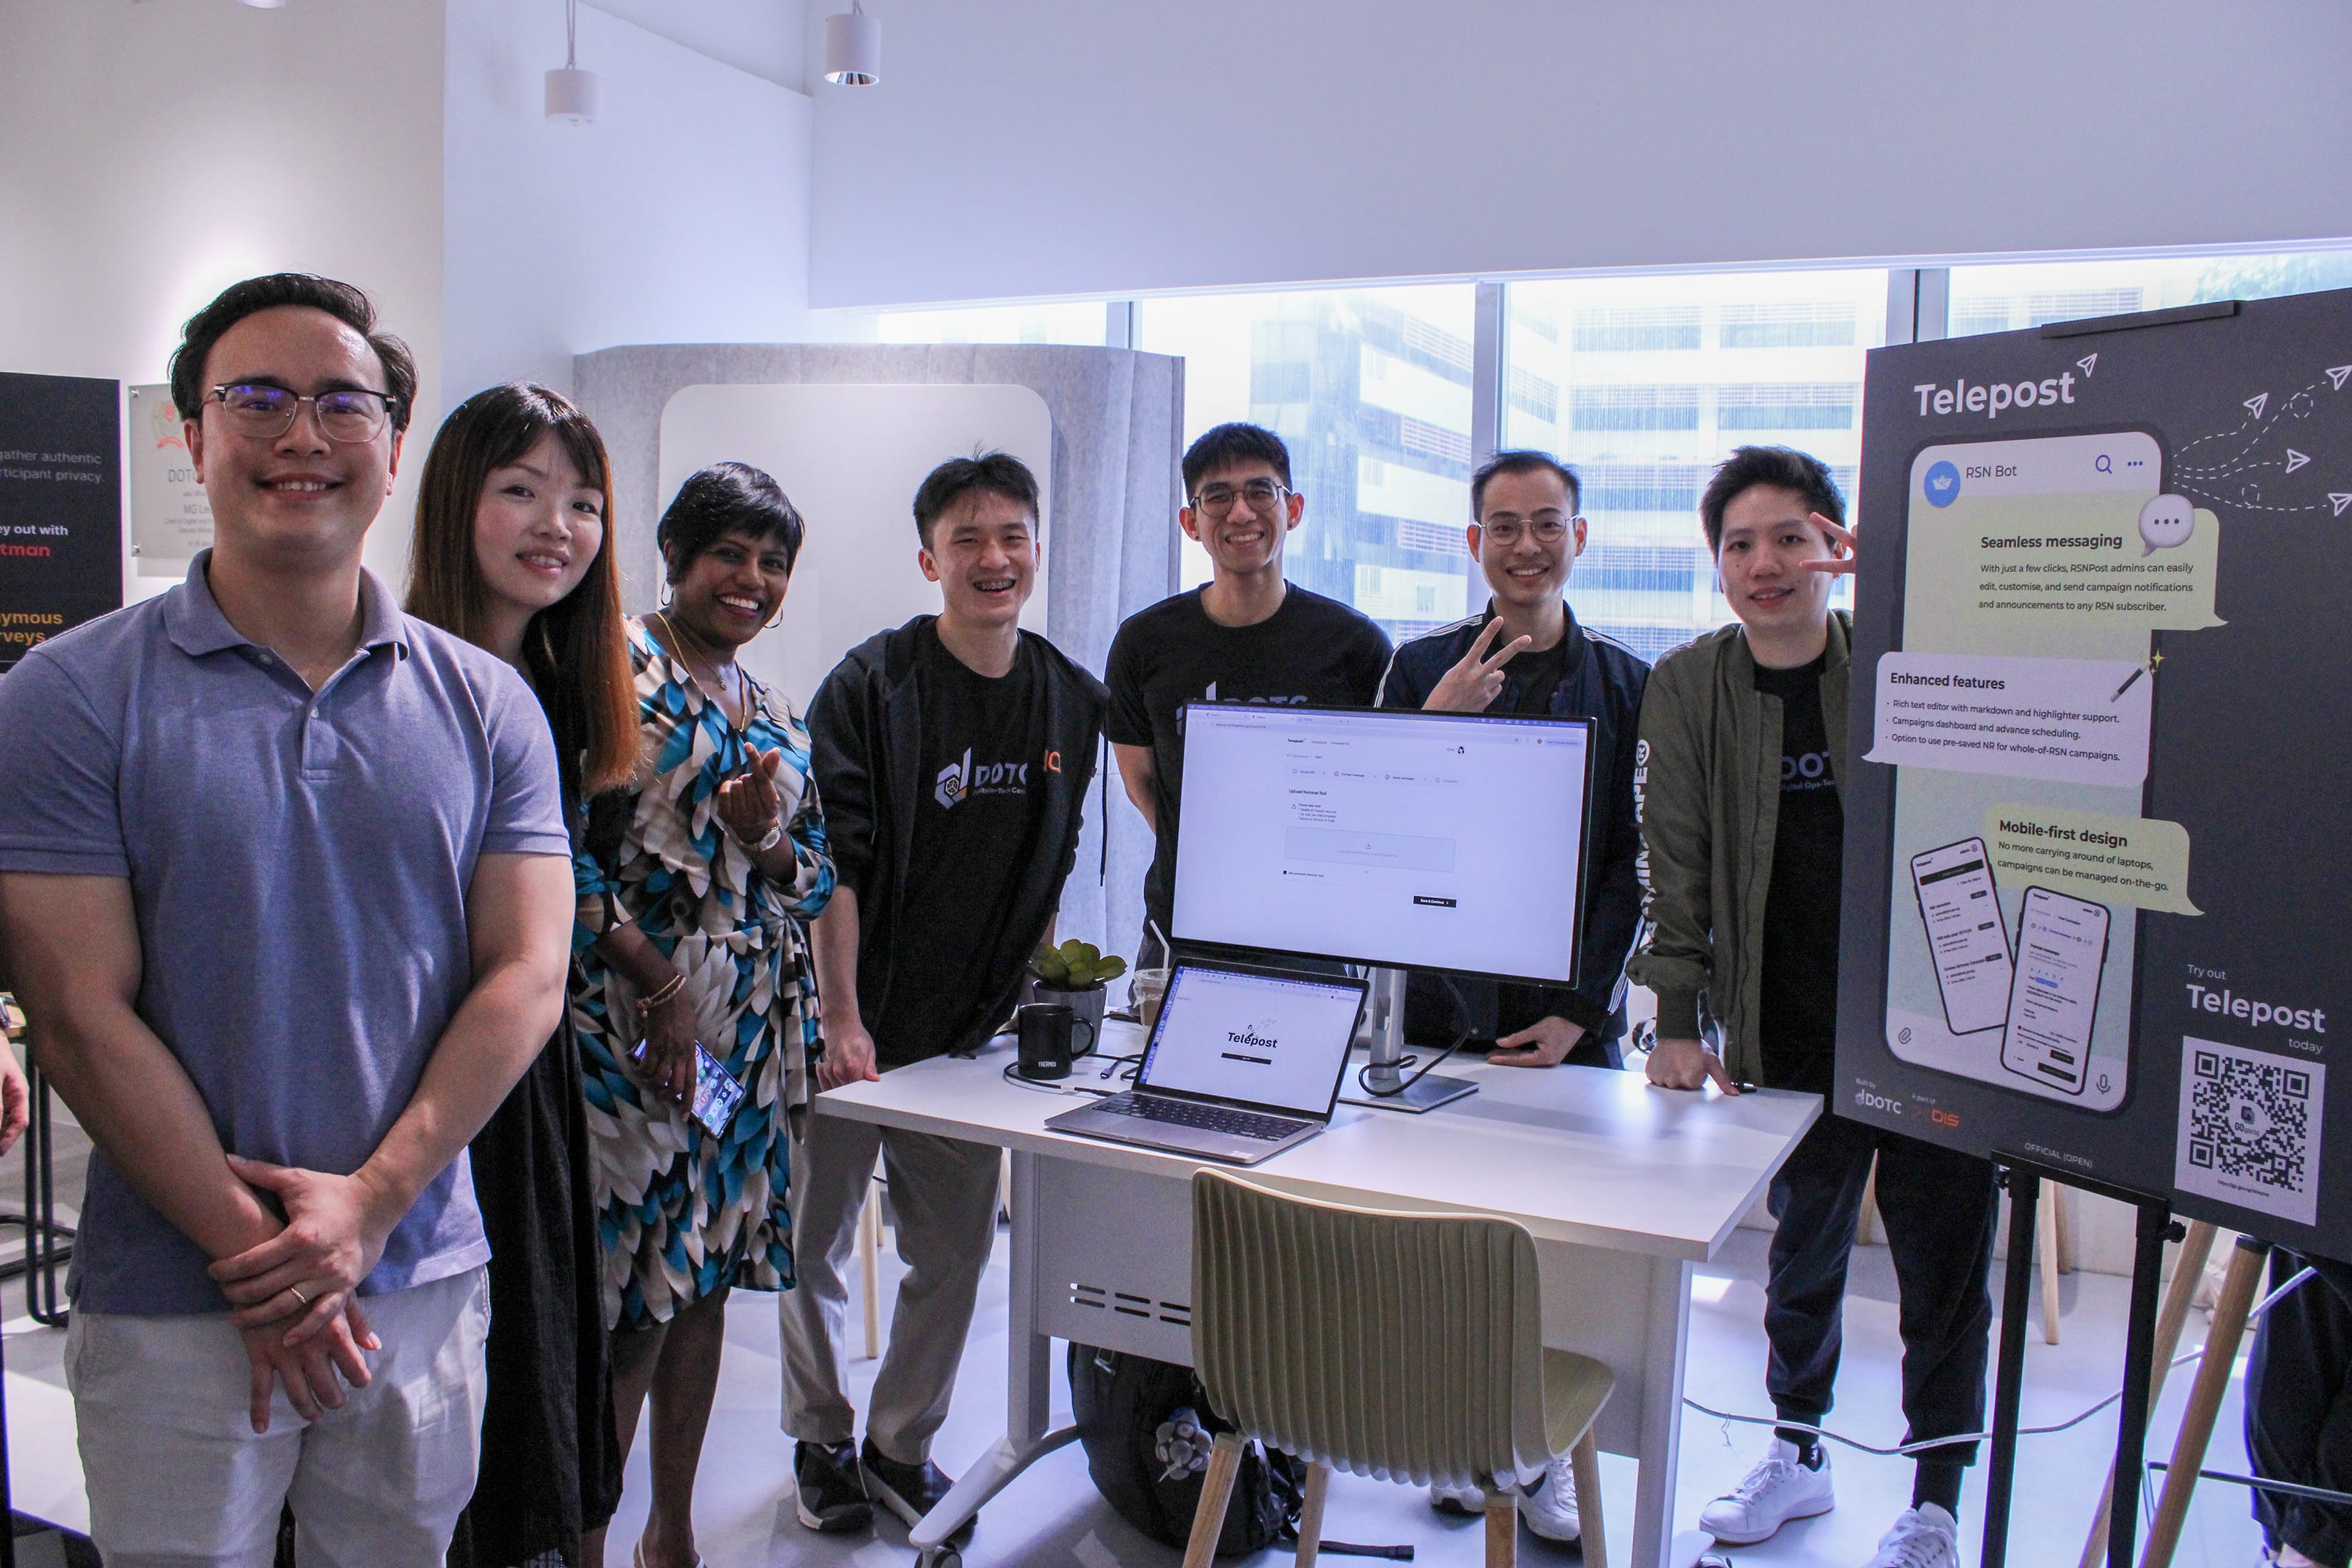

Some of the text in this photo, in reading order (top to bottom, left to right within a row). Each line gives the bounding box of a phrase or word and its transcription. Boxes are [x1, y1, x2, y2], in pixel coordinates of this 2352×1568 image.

[1914, 372, 2075, 419] Telepost
[41, 453, 103, 464] authentic
[56, 471, 105, 484] privacy.
[1966, 465, 2017, 478] RSN Bot
[14, 524, 36, 535] out
[39, 525, 68, 535] with
[1981, 534, 2123, 550] Seamless messaging
[1981, 564, 1999, 572] With
[2001, 564, 2017, 574] just
[2026, 564, 2041, 572] few
[2043, 564, 2068, 574] clicks,
[2111, 564, 2145, 572] admins
[2167, 563, 2194, 574] easily
[1998, 583, 2043, 592] customise,
[2063, 583, 2084, 592] send
[2086, 583, 2132, 594] campaign
[2134, 582, 2193, 592] notifications
[2077, 603, 2093, 612] any
[2116, 601, 2167, 612] subscriber.
[1891, 672, 2005, 690] Enhanced features
[1893, 699, 2120, 723] Rich text editor with markdown and highlighter support.
[1892, 717, 2080, 740] Campaigns dashboard and advance scheduling.
[1892, 734, 1917, 745] Option
[1919, 736, 1927, 744] to
[1943, 738, 1981, 749] pre-saved
[1983, 741, 1995, 750] NR
[1996, 741, 2007, 751] for
[2009, 743, 2067, 756] whole-of-RSN
[2069, 749, 2120, 763] campaigns.
[1999, 820, 2127, 848] Mobile-first design
[1998, 841, 2153, 871] No more carrying around of laptops,
[1997, 859, 2169, 891] campaigns can be managed on-the-go.
[2187, 964, 2227, 980] Try out
[2186, 984, 2326, 1033] Telepost
[1227, 1031, 1278, 1048] Telepost
[2289, 1038, 2323, 1055] today
[1931, 1109, 1959, 1128] DIS
[2024, 1143, 2093, 1169] OFFICIAL (OPEN)
